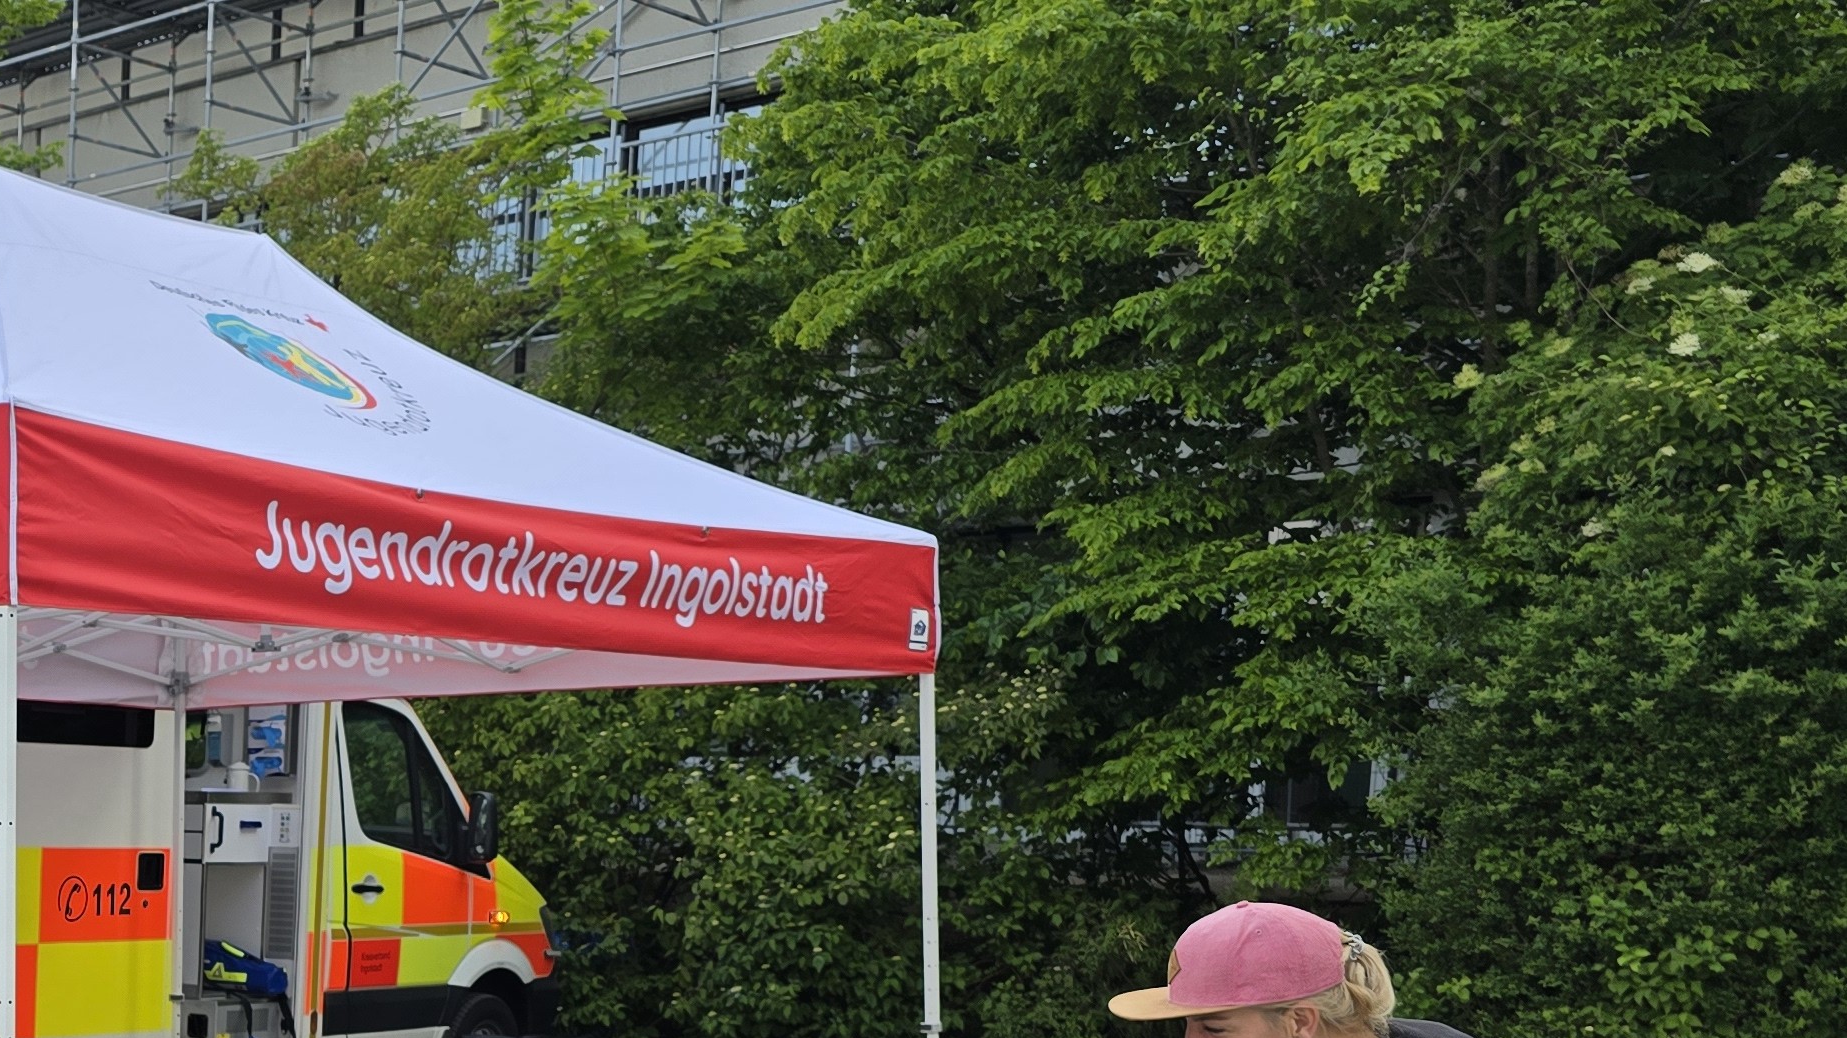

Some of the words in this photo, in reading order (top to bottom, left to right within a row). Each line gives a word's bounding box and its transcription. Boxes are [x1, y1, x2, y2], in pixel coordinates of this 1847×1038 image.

[255, 500, 638, 607] Jugendrotkreuz
[640, 549, 829, 628] Ingolstadt
[93, 882, 131, 916] 112
